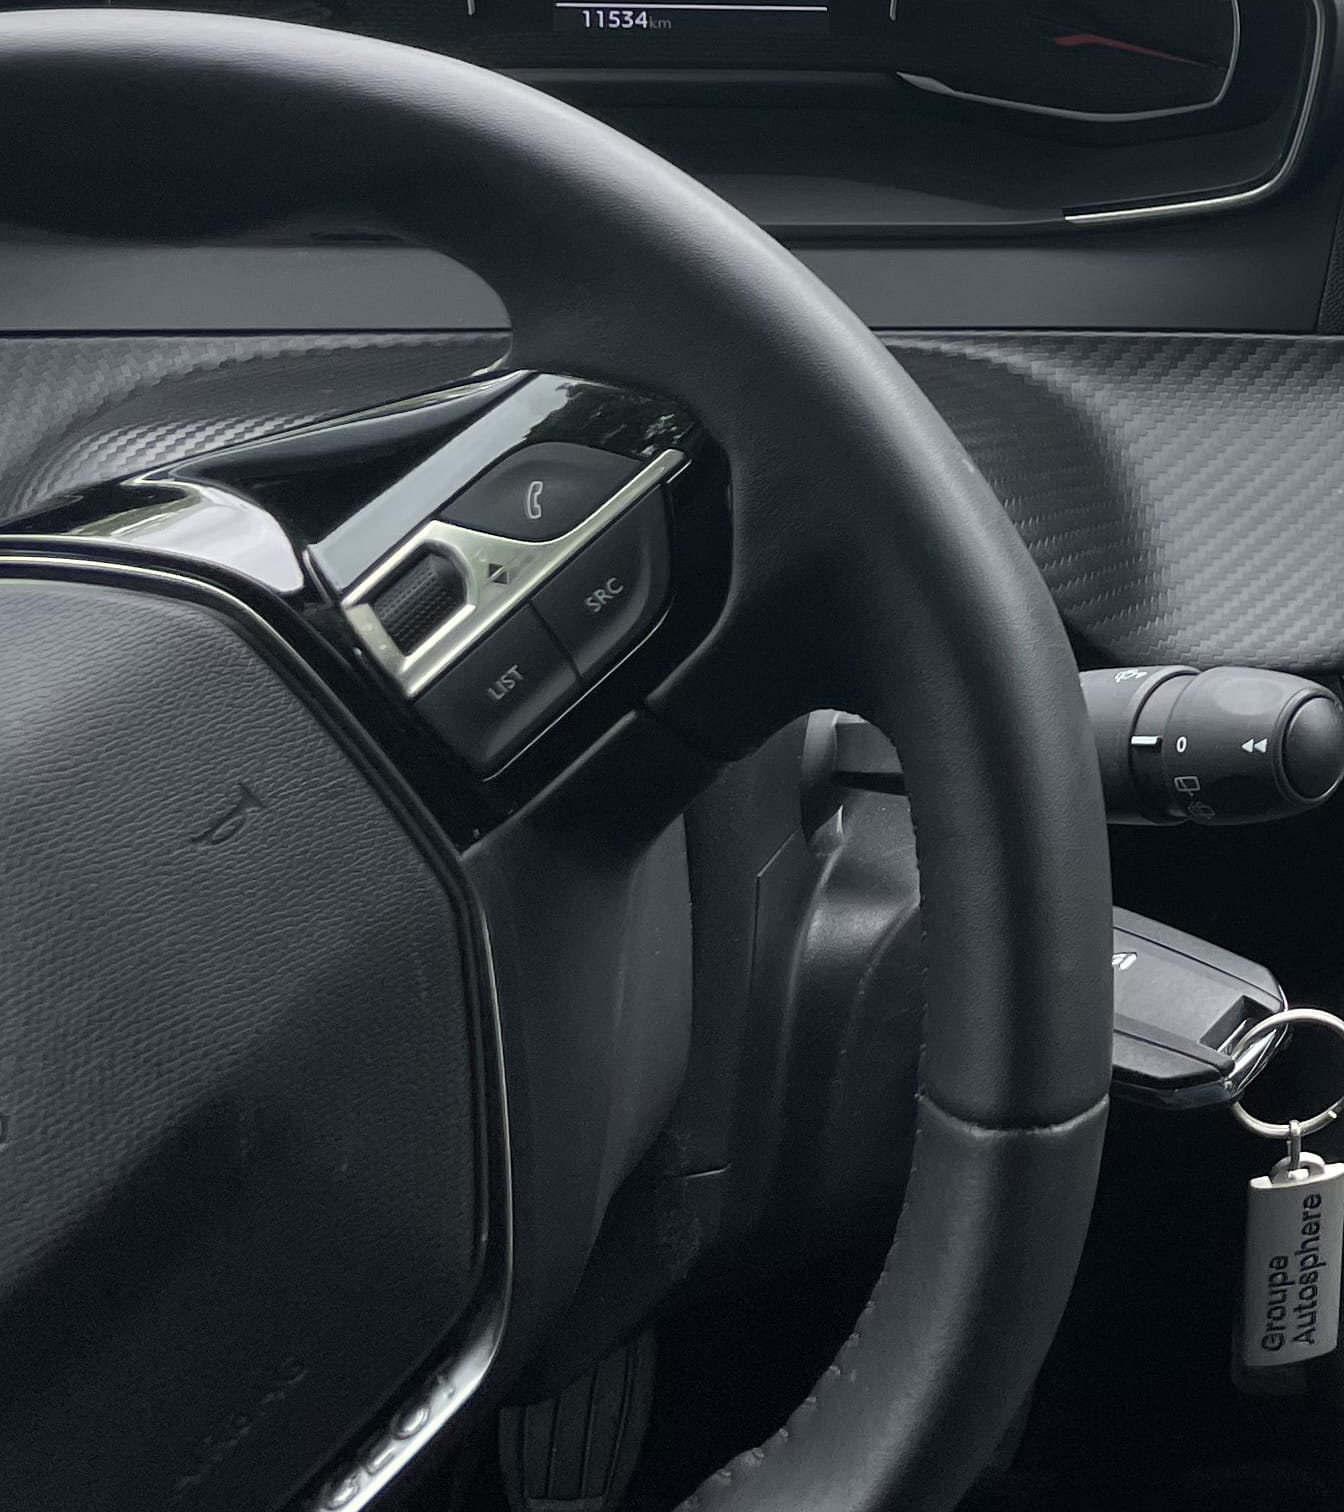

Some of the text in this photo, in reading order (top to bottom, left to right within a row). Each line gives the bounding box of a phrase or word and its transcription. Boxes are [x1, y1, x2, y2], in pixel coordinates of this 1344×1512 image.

[585, 577, 624, 613] SRC
[488, 664, 524, 700] LIST
[1291, 1192, 1327, 1346] Autosphere
[1262, 1255, 1296, 1352] Groupe
